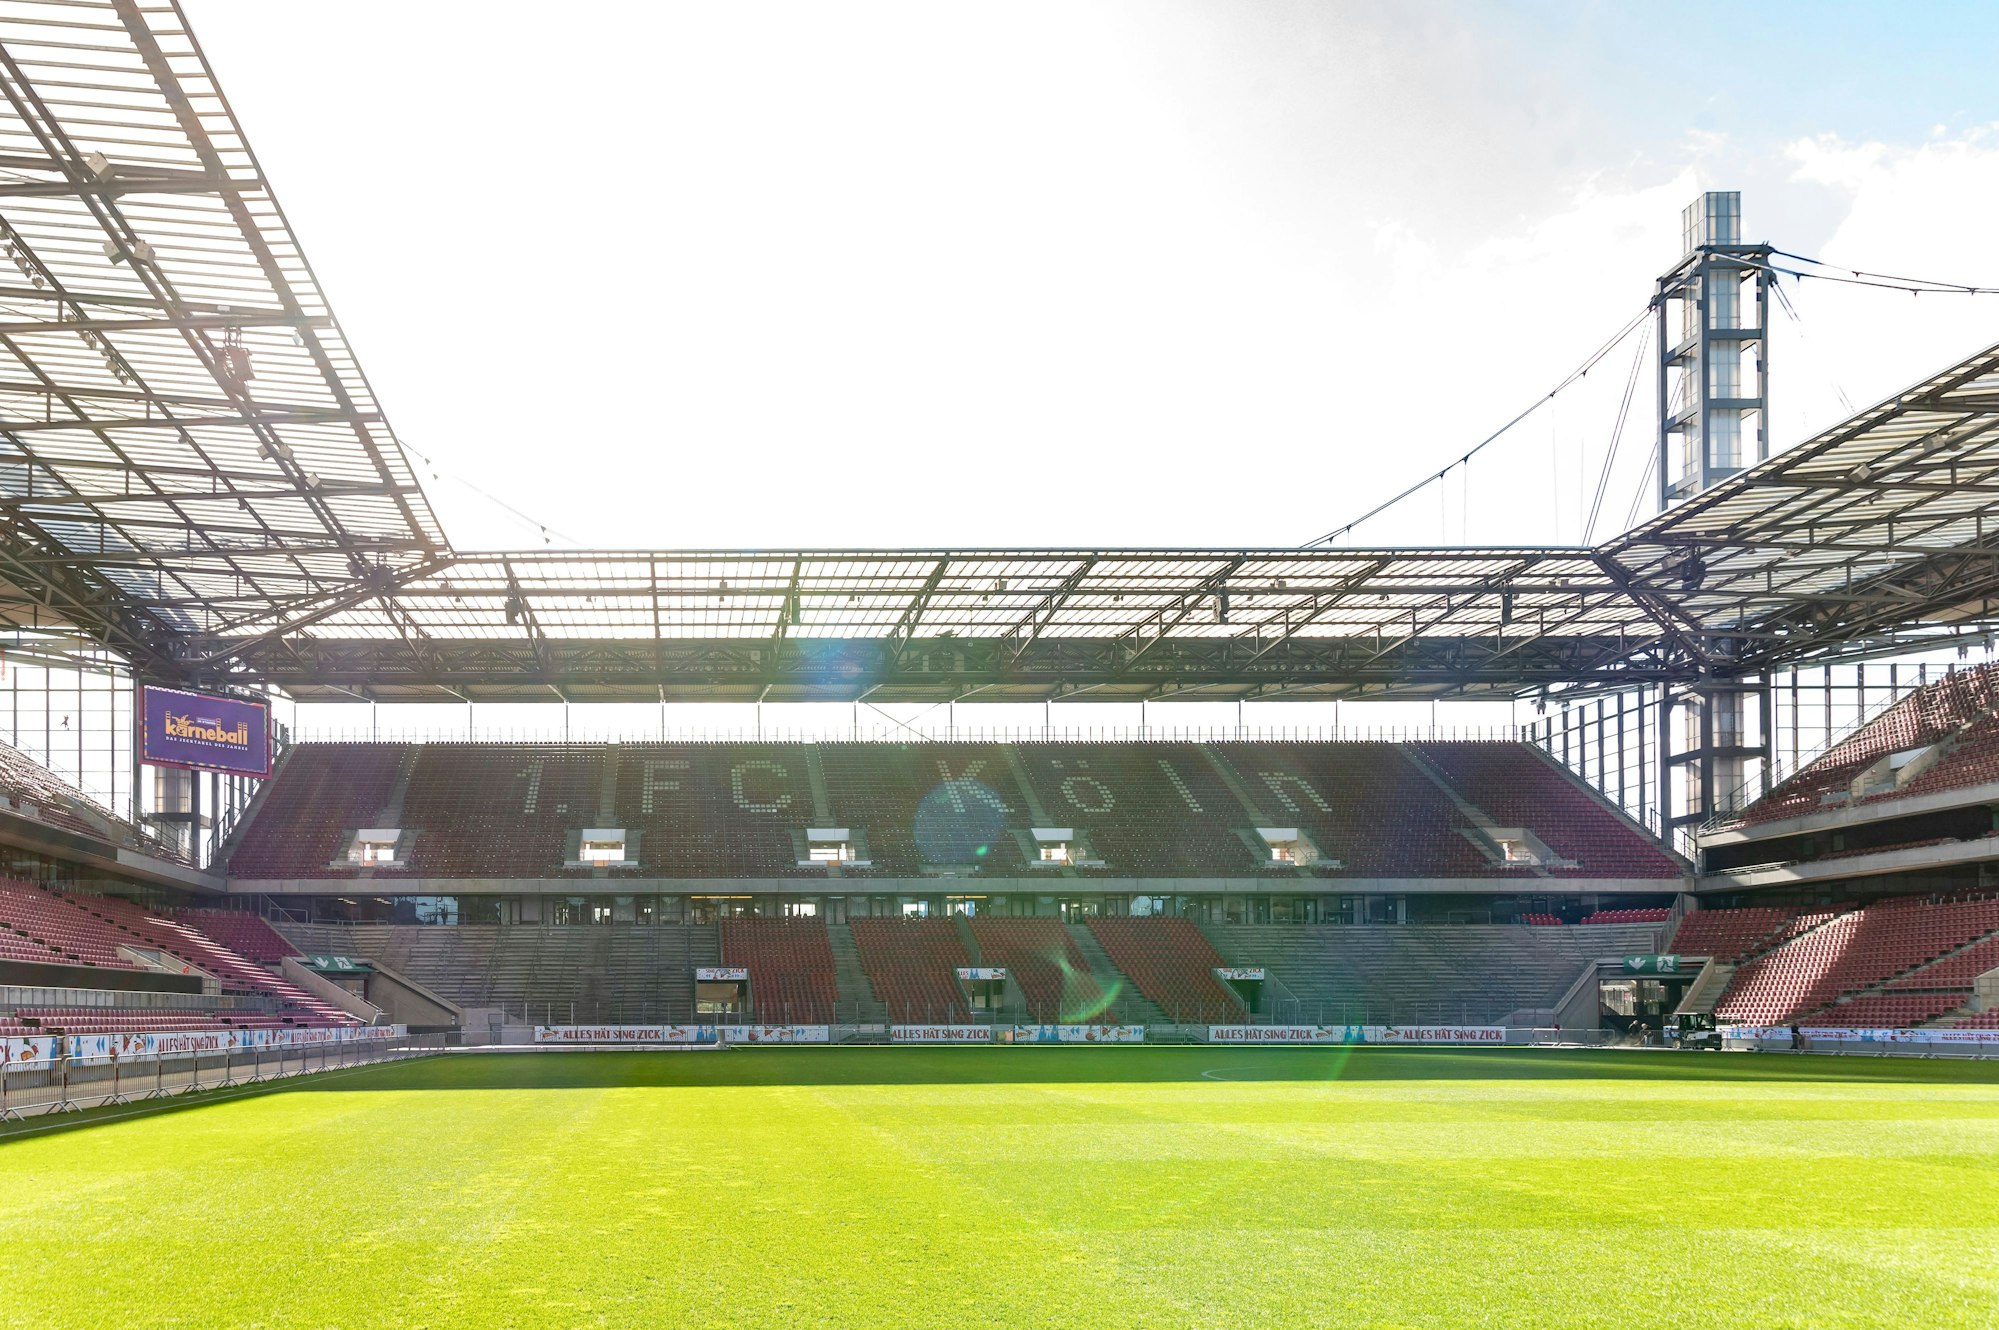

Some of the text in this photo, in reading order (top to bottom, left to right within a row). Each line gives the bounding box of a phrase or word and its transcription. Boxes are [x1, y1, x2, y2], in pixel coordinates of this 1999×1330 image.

[165, 711, 248, 745] karneball
[516, 760, 1332, 813] 1. FC Köln
[563, 1028, 660, 1039] ALLES HÄT SING ZICK
[892, 1028, 989, 1039] ALLES HÄT SING ZICK
[1214, 1028, 1312, 1039] ALLES HÄT SING ZICK
[1403, 1028, 1502, 1040] ALLES HÄT SING ZICK
[158, 1037, 179, 1052] ALLES
